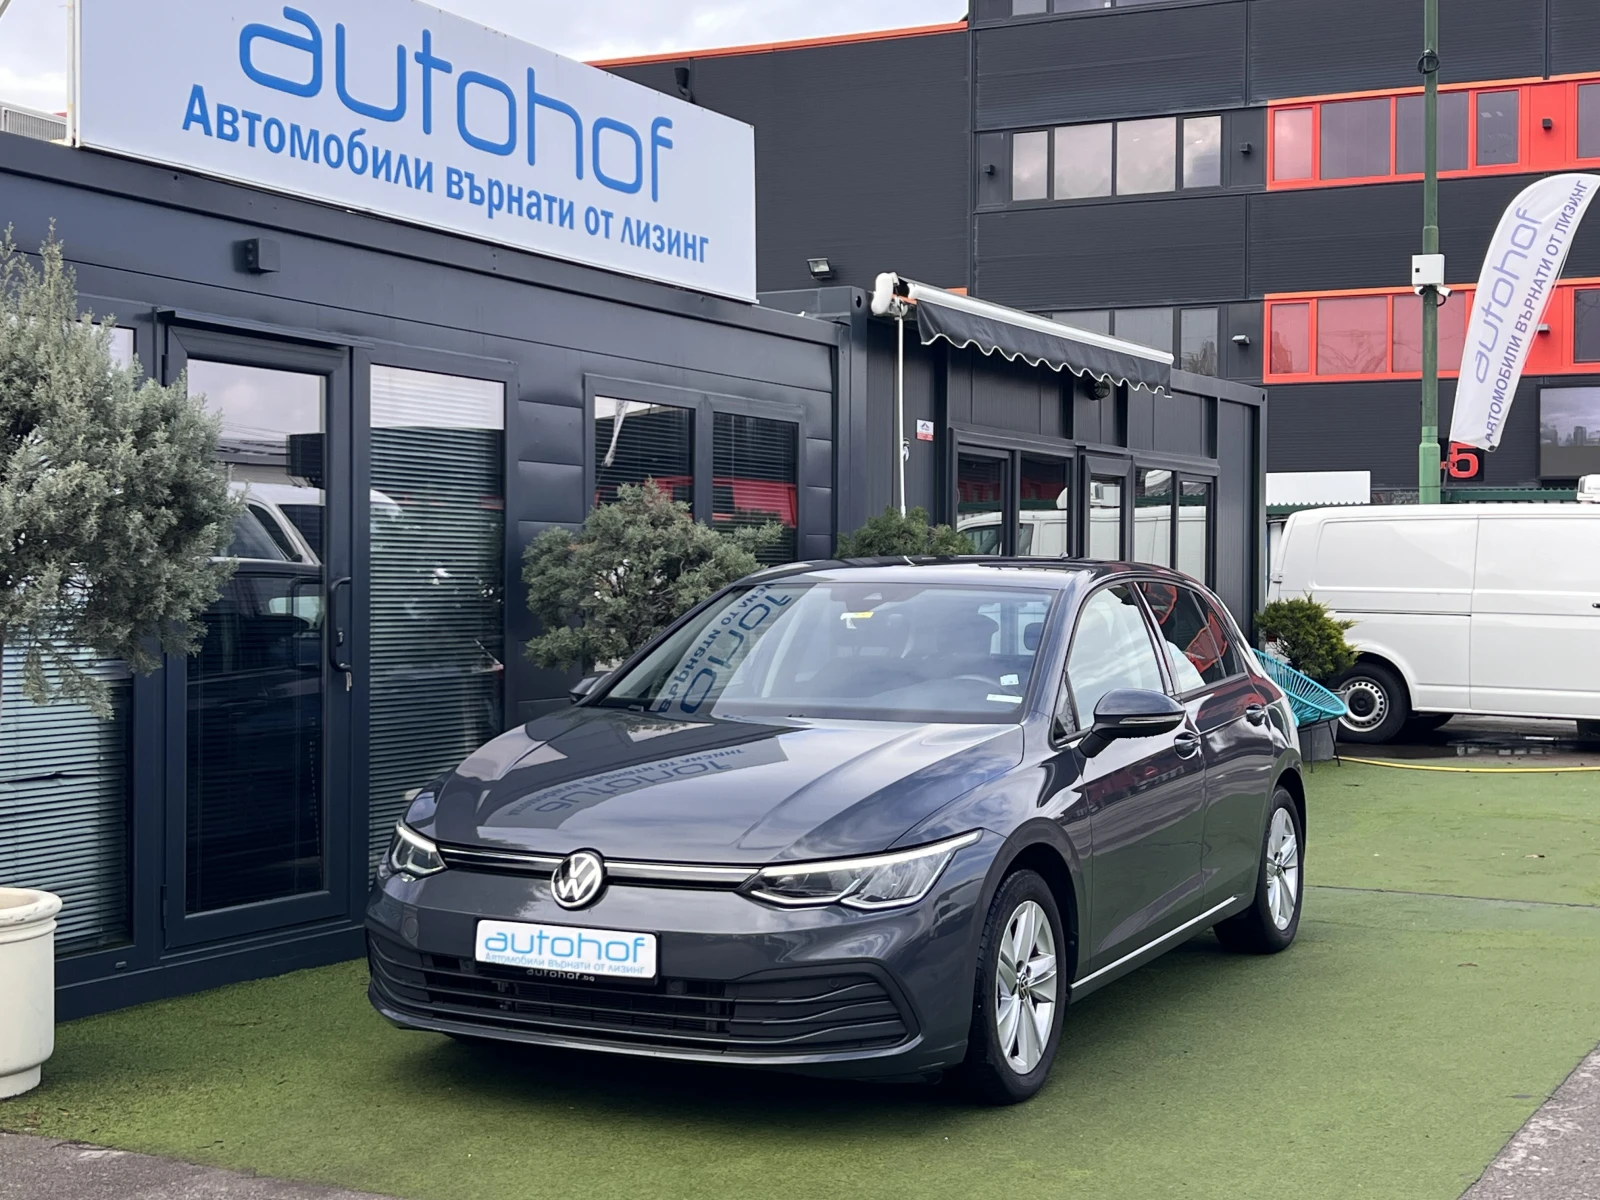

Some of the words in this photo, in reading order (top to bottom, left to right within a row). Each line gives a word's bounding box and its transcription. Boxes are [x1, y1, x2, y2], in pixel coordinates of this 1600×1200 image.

[239, 6, 674, 202] autohof
[182, 84, 433, 193] Автомобили
[446, 166, 574, 230] върнати
[584, 206, 614, 239] от
[621, 216, 709, 263] лизинг
[1554, 180, 1589, 235] ЛИЗИНГ
[1546, 233, 1563, 257] ОТ
[1474, 207, 1542, 384] autohof
[1514, 258, 1554, 334] ВЪРНАТИ
[1484, 334, 1523, 443] АВТОМОБИЛИ
[485, 930, 645, 962] autohof
[485, 952, 545, 967] Автомобили
[548, 959, 591, 970] върнати
[594, 962, 605, 972] от
[607, 965, 645, 974] лизинг
